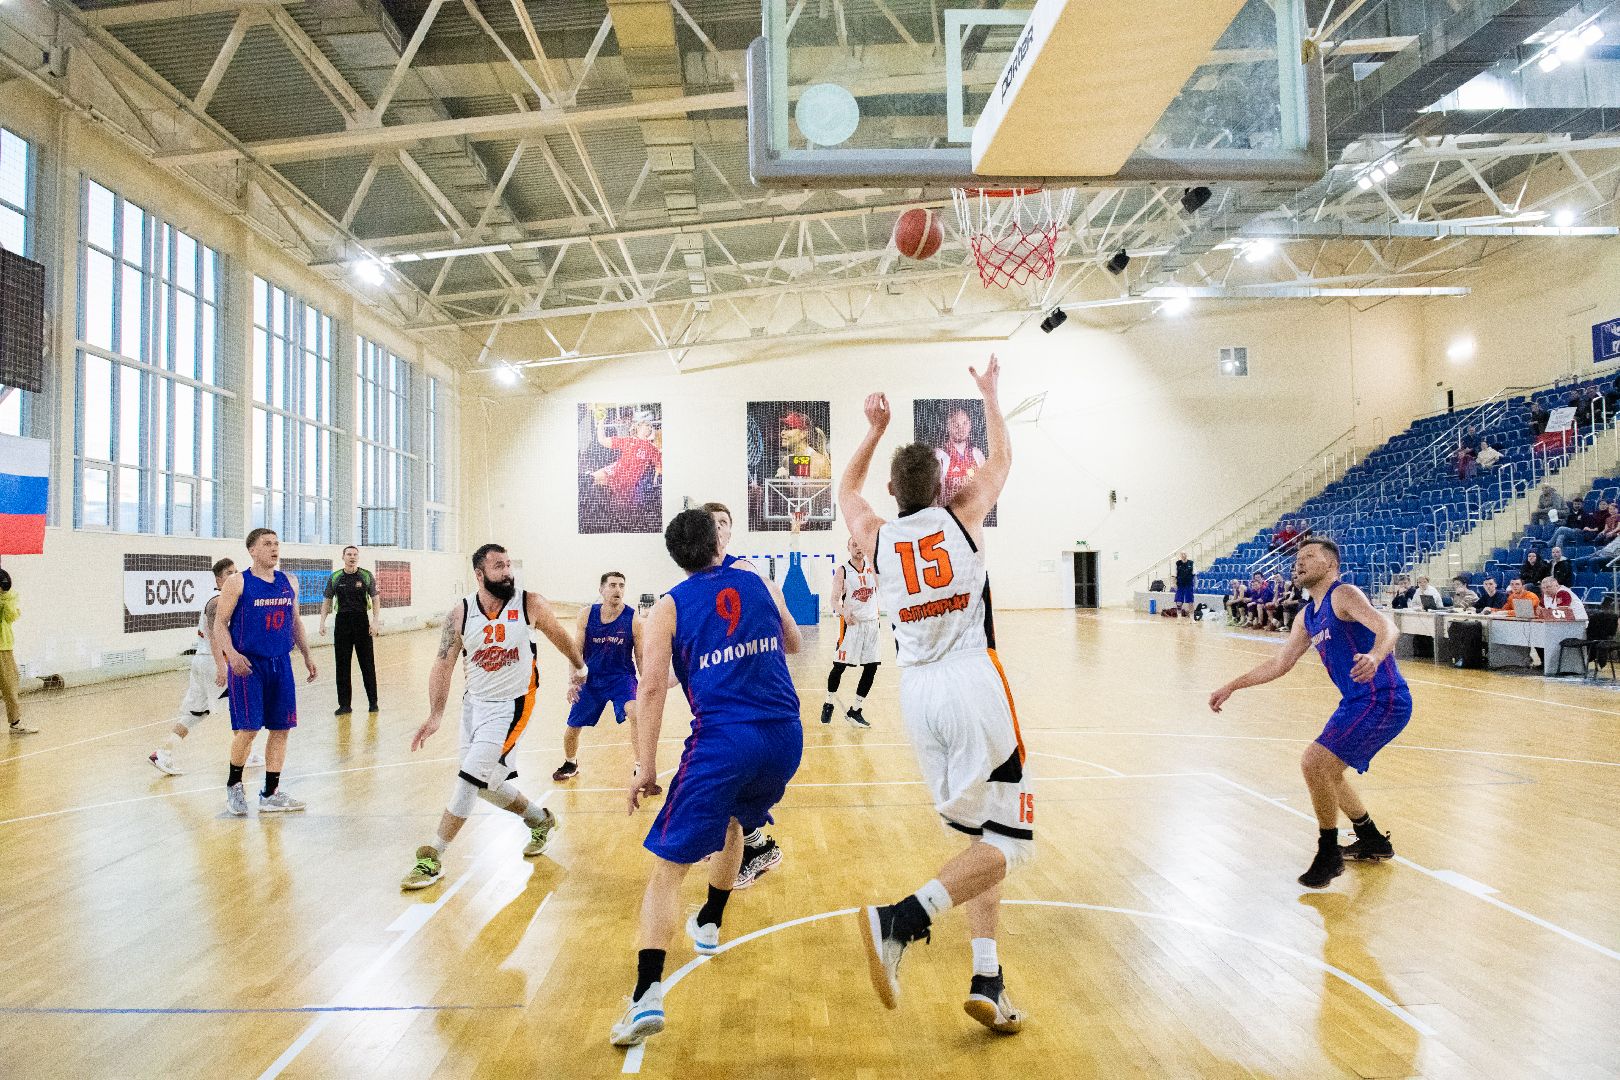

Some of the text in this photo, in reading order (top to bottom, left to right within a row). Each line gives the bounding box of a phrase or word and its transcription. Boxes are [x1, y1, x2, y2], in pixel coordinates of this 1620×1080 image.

[894, 530, 954, 595] 15
[145, 579, 195, 606] БОКС
[265, 609, 286, 632] 10
[716, 587, 741, 638] 9
[699, 636, 778, 670] КОЛОМНА
[1019, 792, 1034, 824] 15
